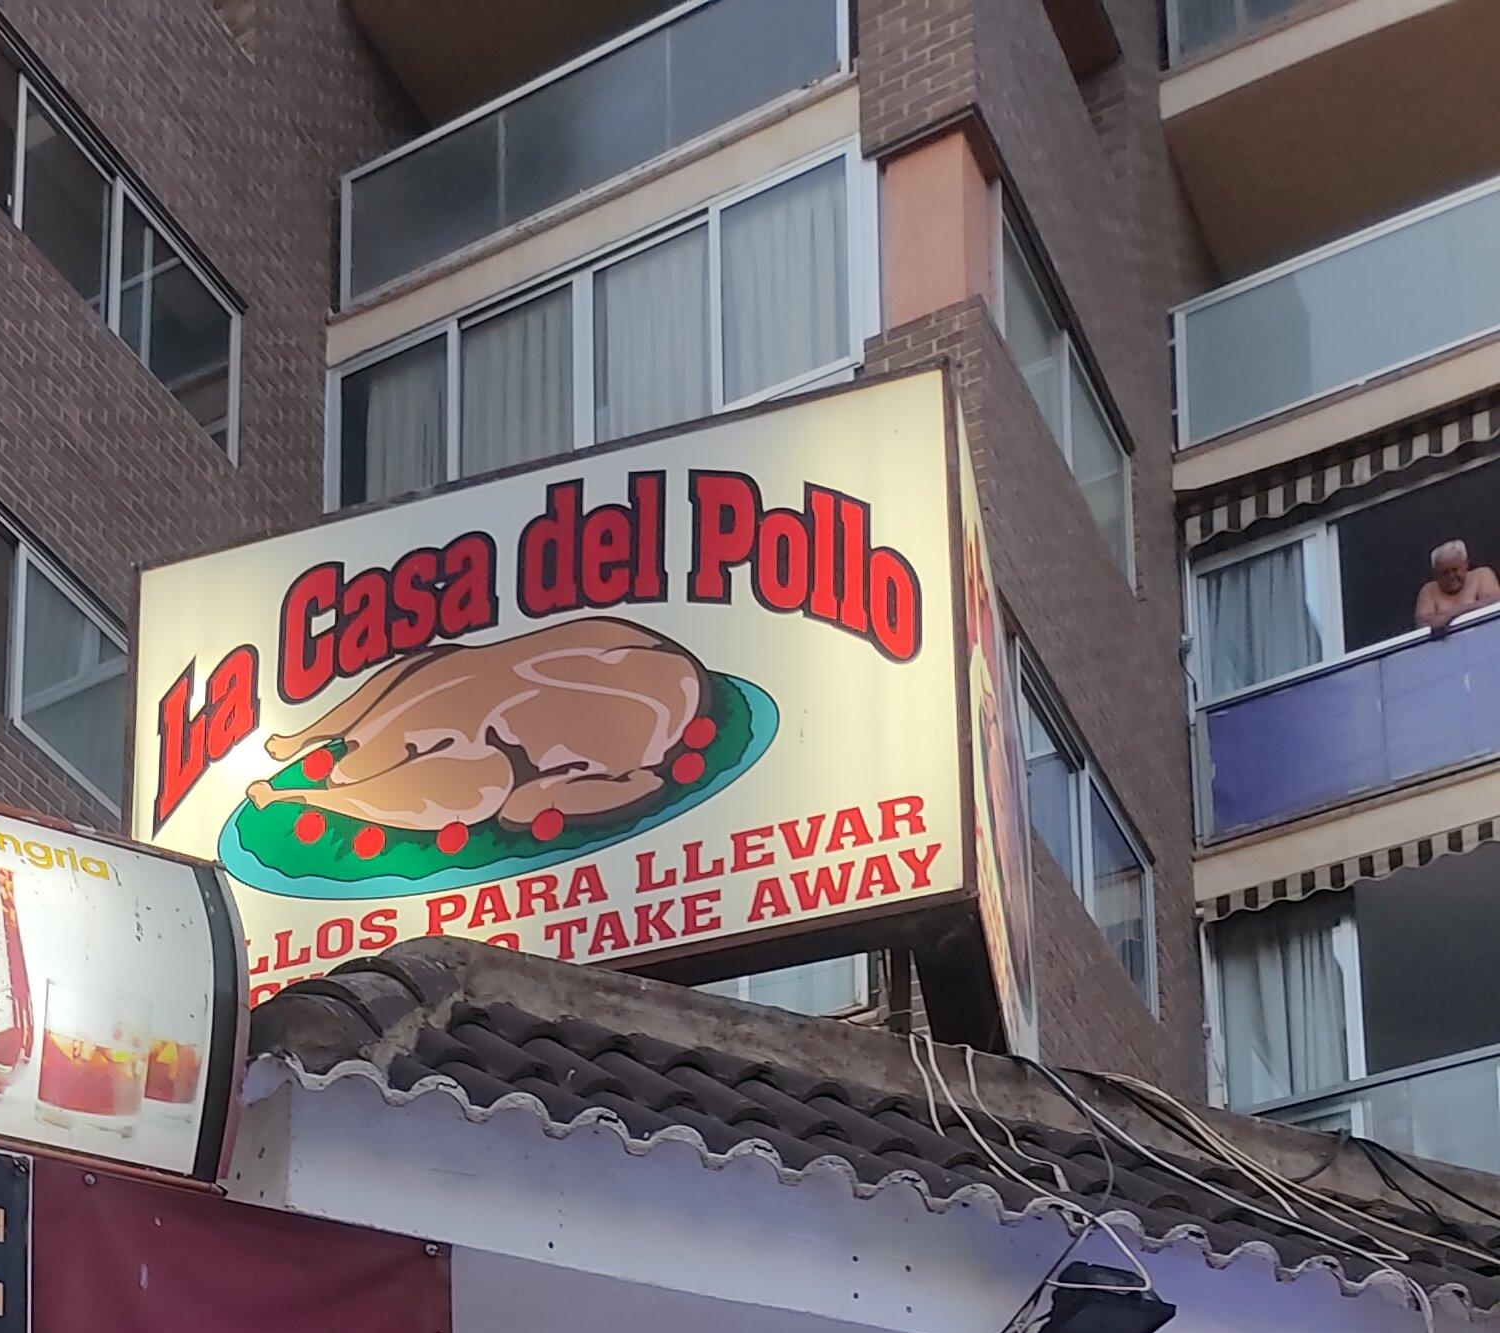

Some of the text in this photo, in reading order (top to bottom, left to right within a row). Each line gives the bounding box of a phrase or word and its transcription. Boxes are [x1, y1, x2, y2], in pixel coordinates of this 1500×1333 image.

[152, 468, 923, 840] La Casa del Pollo
[425, 864, 609, 937] PARA
[635, 794, 928, 894] LLEVAR
[545, 844, 943, 961] TAKE AWAY
